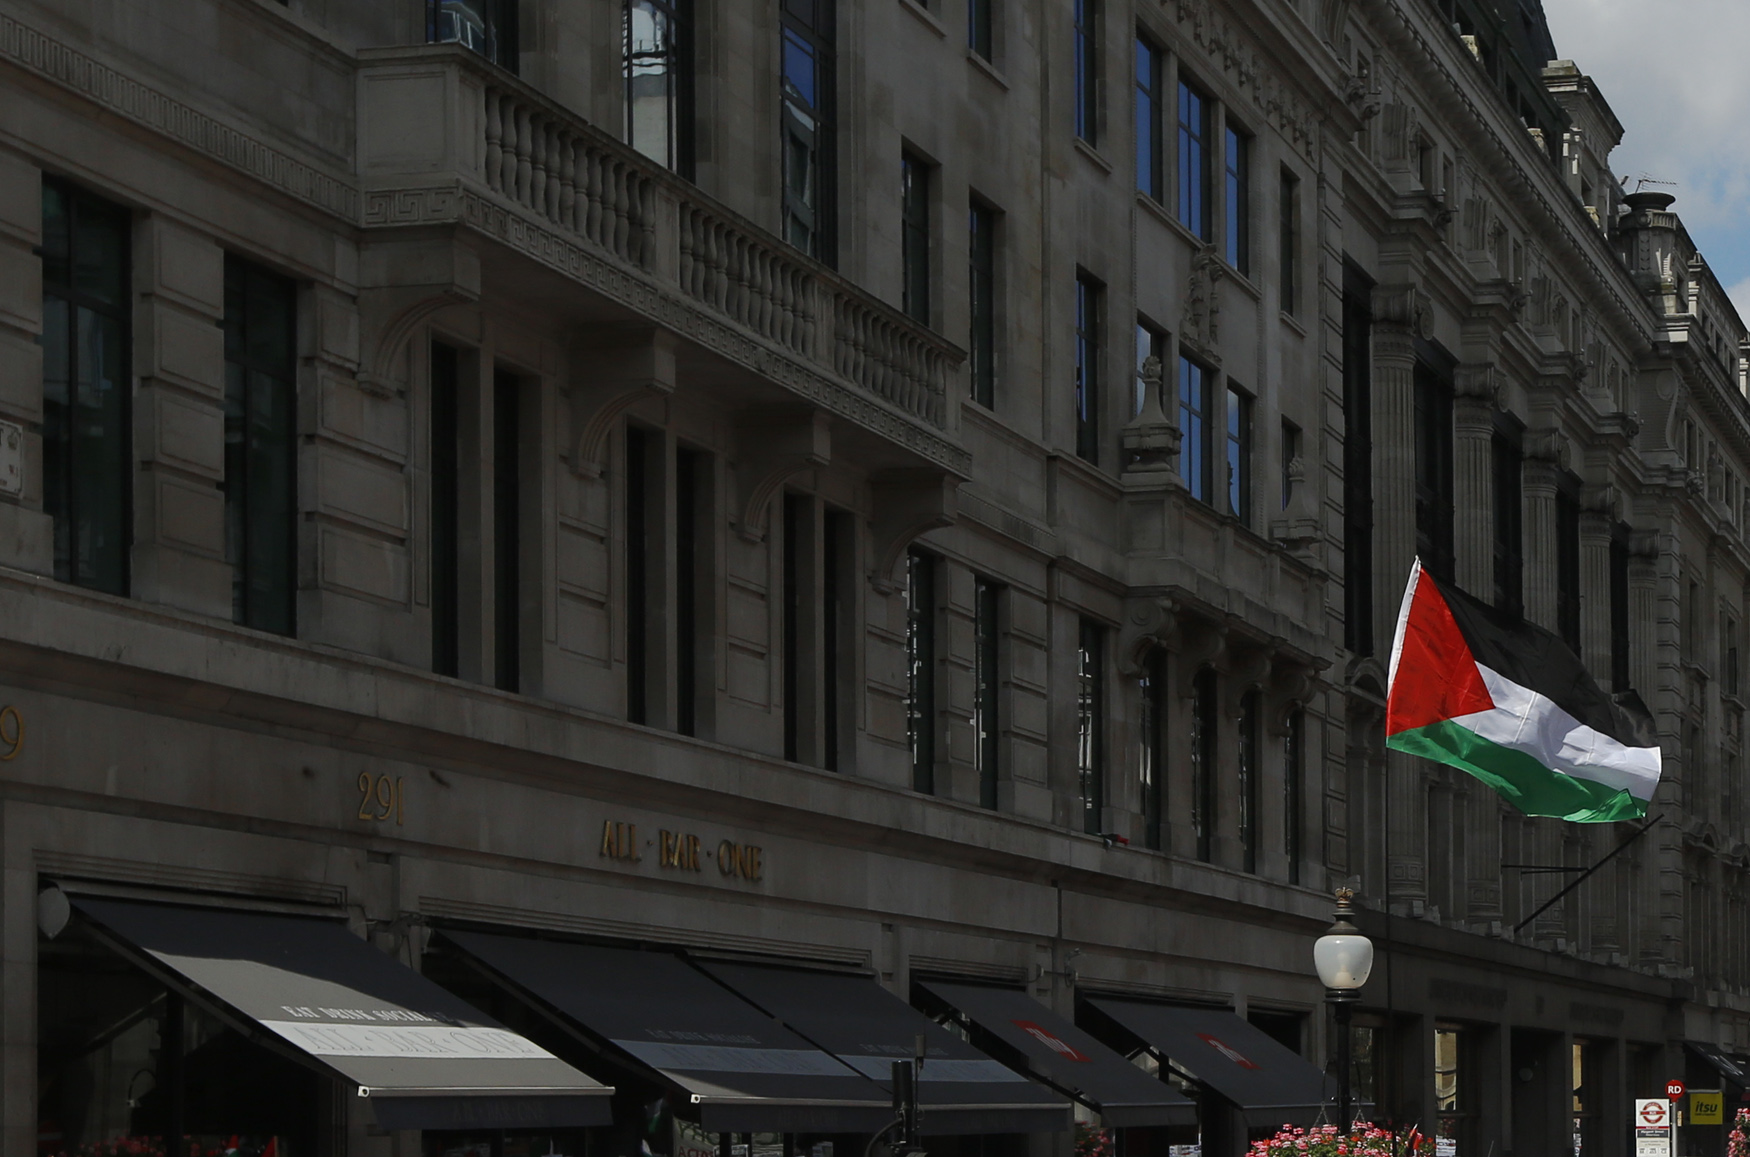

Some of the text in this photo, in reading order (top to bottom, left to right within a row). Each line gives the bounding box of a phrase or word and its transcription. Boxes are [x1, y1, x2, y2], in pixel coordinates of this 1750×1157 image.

[358, 772, 403, 826] 291
[600, 821, 762, 881] ALL BAR ONE
[282, 1005, 376, 1020] EAT DRINK
[1668, 1085, 1682, 1094] RD
[1695, 1101, 1718, 1112] itsu
